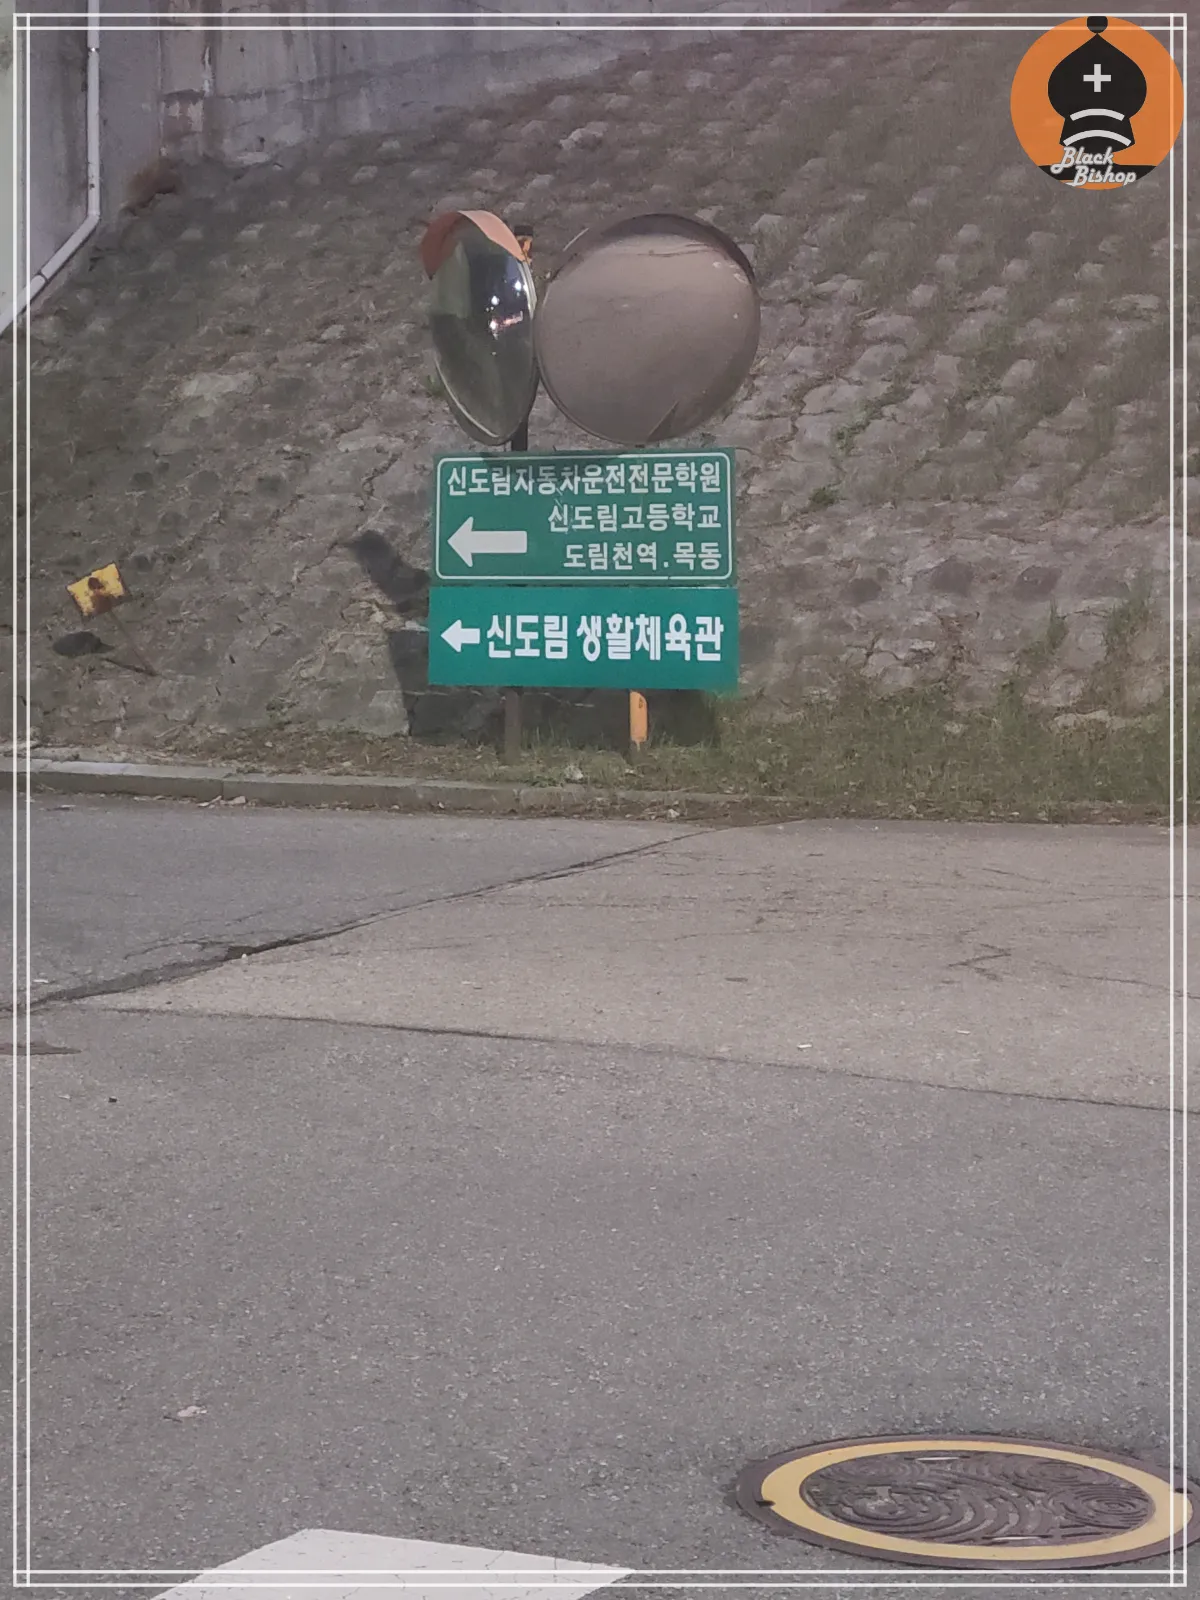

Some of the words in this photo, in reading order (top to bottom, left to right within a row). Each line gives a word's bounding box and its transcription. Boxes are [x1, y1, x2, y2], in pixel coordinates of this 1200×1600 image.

[447, 461, 722, 496] 신도림자동차운전전문학원
[548, 503, 722, 532] 신도림고등학교
[486, 614, 569, 659] 신도림
[576, 613, 724, 662] 생활체육관
